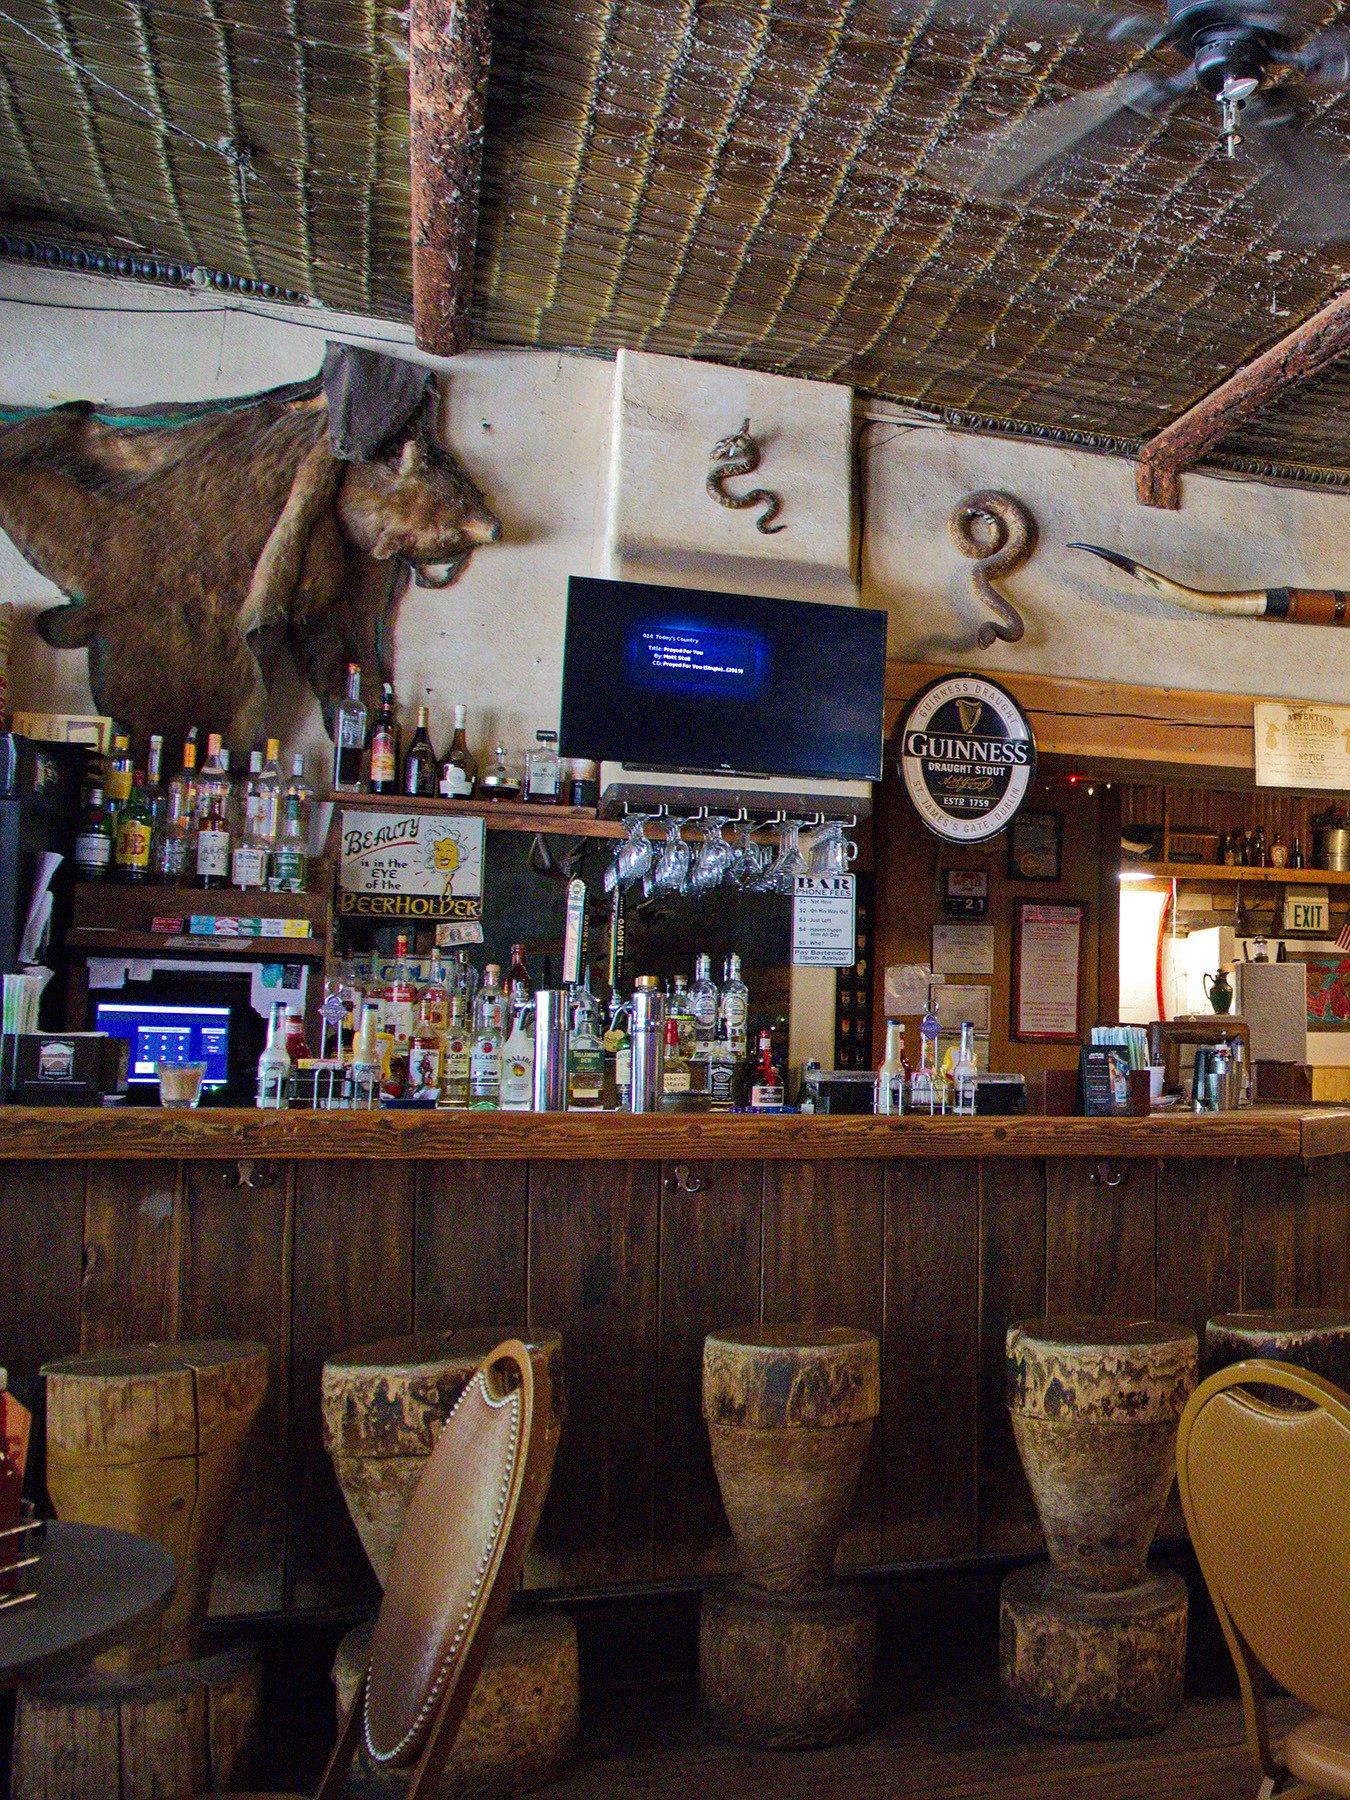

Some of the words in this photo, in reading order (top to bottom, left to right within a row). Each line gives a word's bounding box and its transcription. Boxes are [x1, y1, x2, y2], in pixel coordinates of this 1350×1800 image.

[920, 684, 968, 718] GUINNESS
[974, 685, 1018, 724] DRAUGHT
[908, 733, 1028, 764] GUINNESS
[1299, 753, 1325, 761] NOTICE
[928, 762, 972, 774] DRAUGHT
[975, 765, 1006, 777] STOUT
[923, 800, 958, 832] JAMES'S
[994, 786, 1021, 822] DUBLIN
[970, 799, 990, 808] 1759
[344, 816, 421, 855] BEAUTY
[360, 859, 370, 867] is
[374, 859, 384, 868] in
[388, 859, 408, 869] the
[372, 869, 397, 878] EYE
[365, 881, 378, 889] of
[382, 881, 402, 890] the
[798, 877, 850, 889] BAR
[340, 892, 482, 916] BEERHOLDER
[1294, 905, 1322, 927] EXIT
